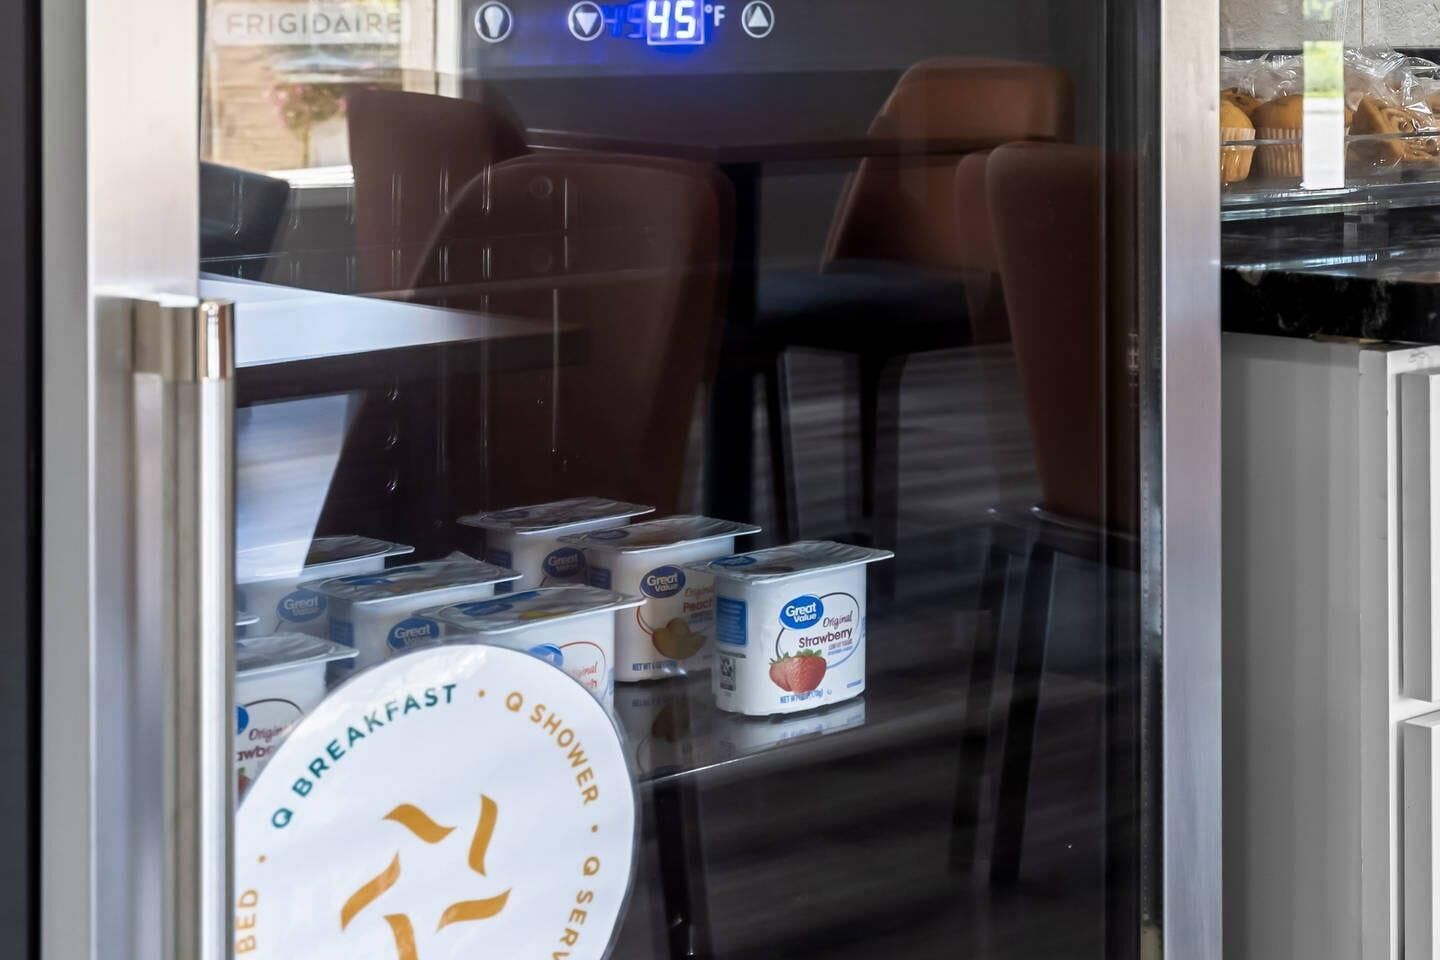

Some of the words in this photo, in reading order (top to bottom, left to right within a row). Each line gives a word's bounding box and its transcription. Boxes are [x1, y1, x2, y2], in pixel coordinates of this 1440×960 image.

[226, 12, 401, 34] FRIGIDAIRE
[648, 0, 696, 39] 45
[646, 574, 678, 586] Great
[284, 597, 318, 611] Great
[785, 602, 817, 617] Great
[793, 613, 817, 623] Value
[822, 610, 853, 629] Original
[394, 625, 430, 639] Great
[799, 628, 853, 648] Strawberry
[271, 807, 294, 829] Q
[292, 684, 457, 798] BREAKFAST
[505, 691, 524, 713] Q
[529, 703, 600, 805] SHOWER
[583, 856, 601, 876] Q
[235, 888, 258, 954] BED
